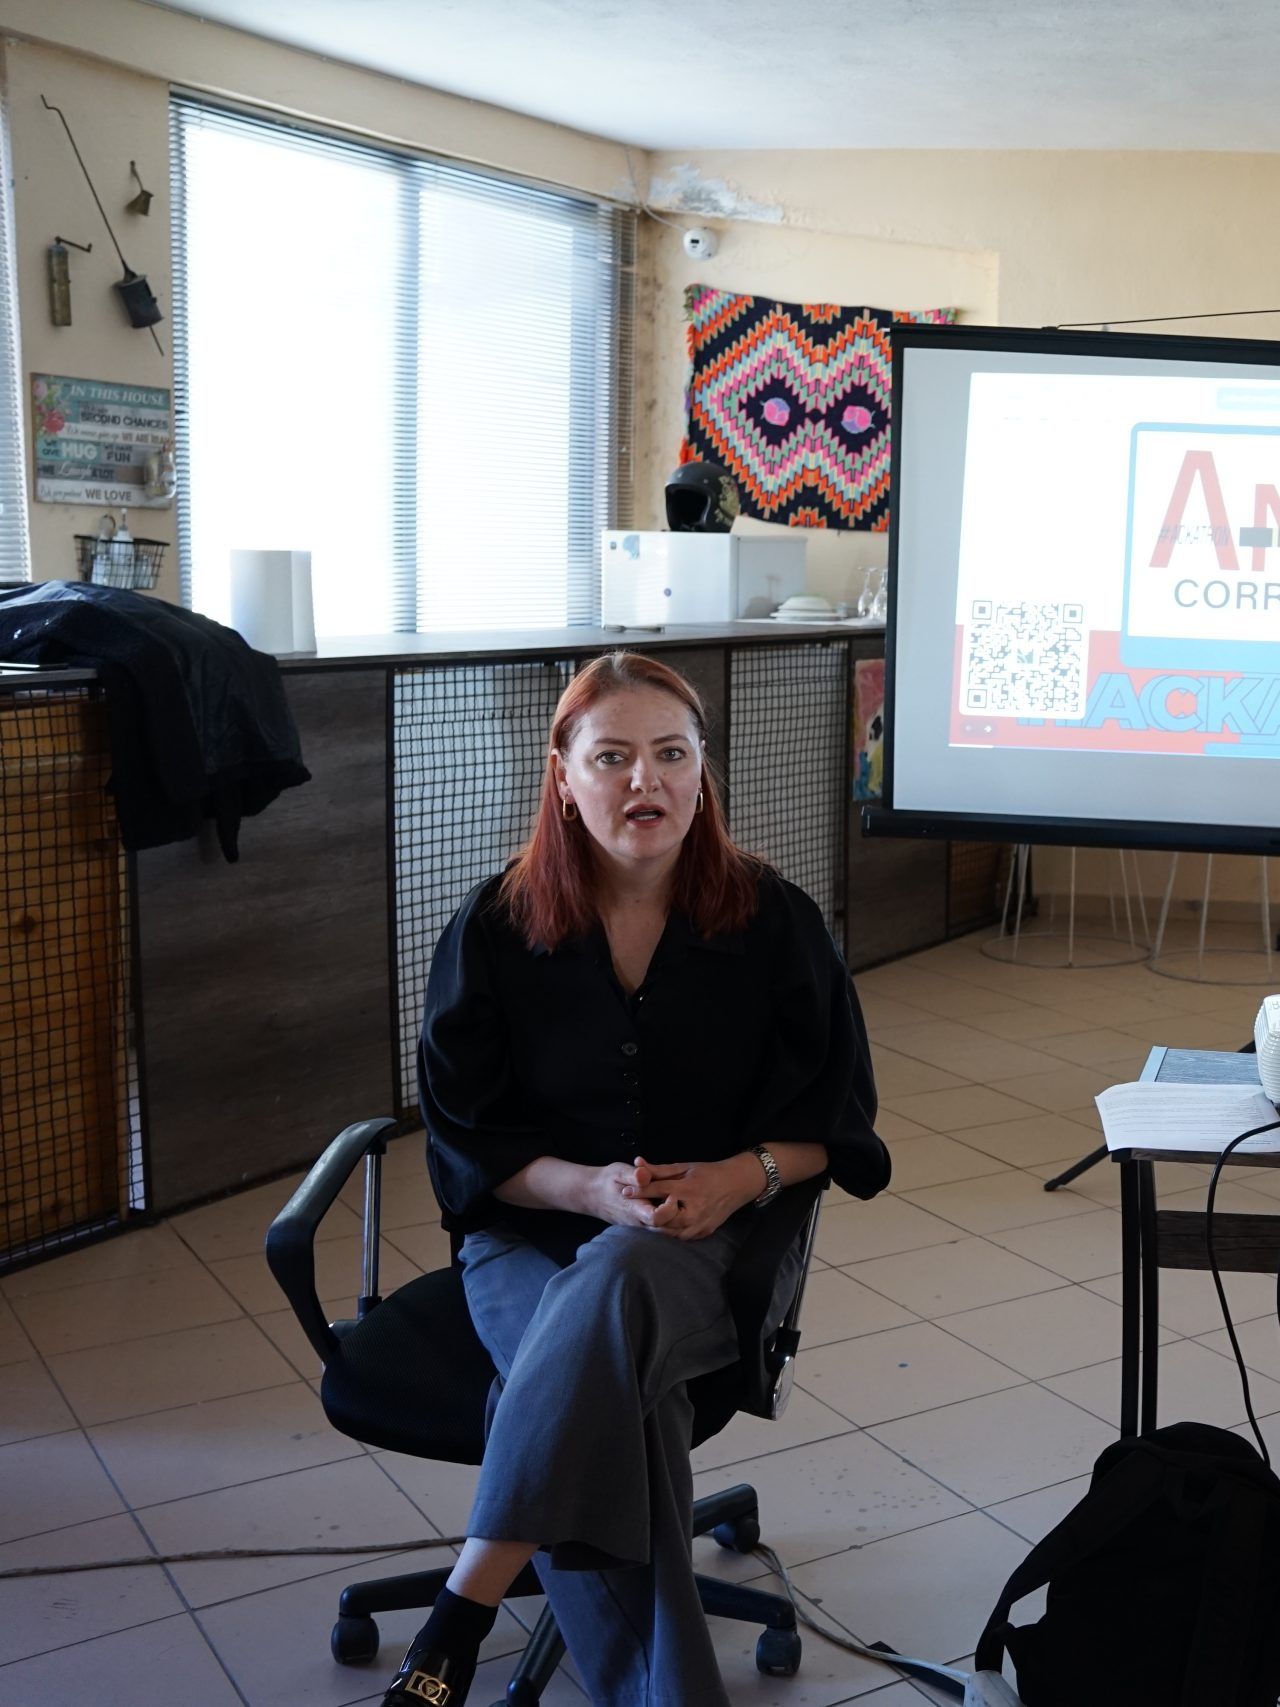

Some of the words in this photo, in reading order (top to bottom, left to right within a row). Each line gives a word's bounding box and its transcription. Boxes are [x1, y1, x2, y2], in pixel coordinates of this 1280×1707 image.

[70, 384, 86, 396] IN
[90, 387, 120, 400] THIS
[122, 391, 166, 406] HOUSE
[81, 412, 120, 425] SECOND
[106, 452, 131, 462] FUN
[104, 490, 132, 501] LOVE
